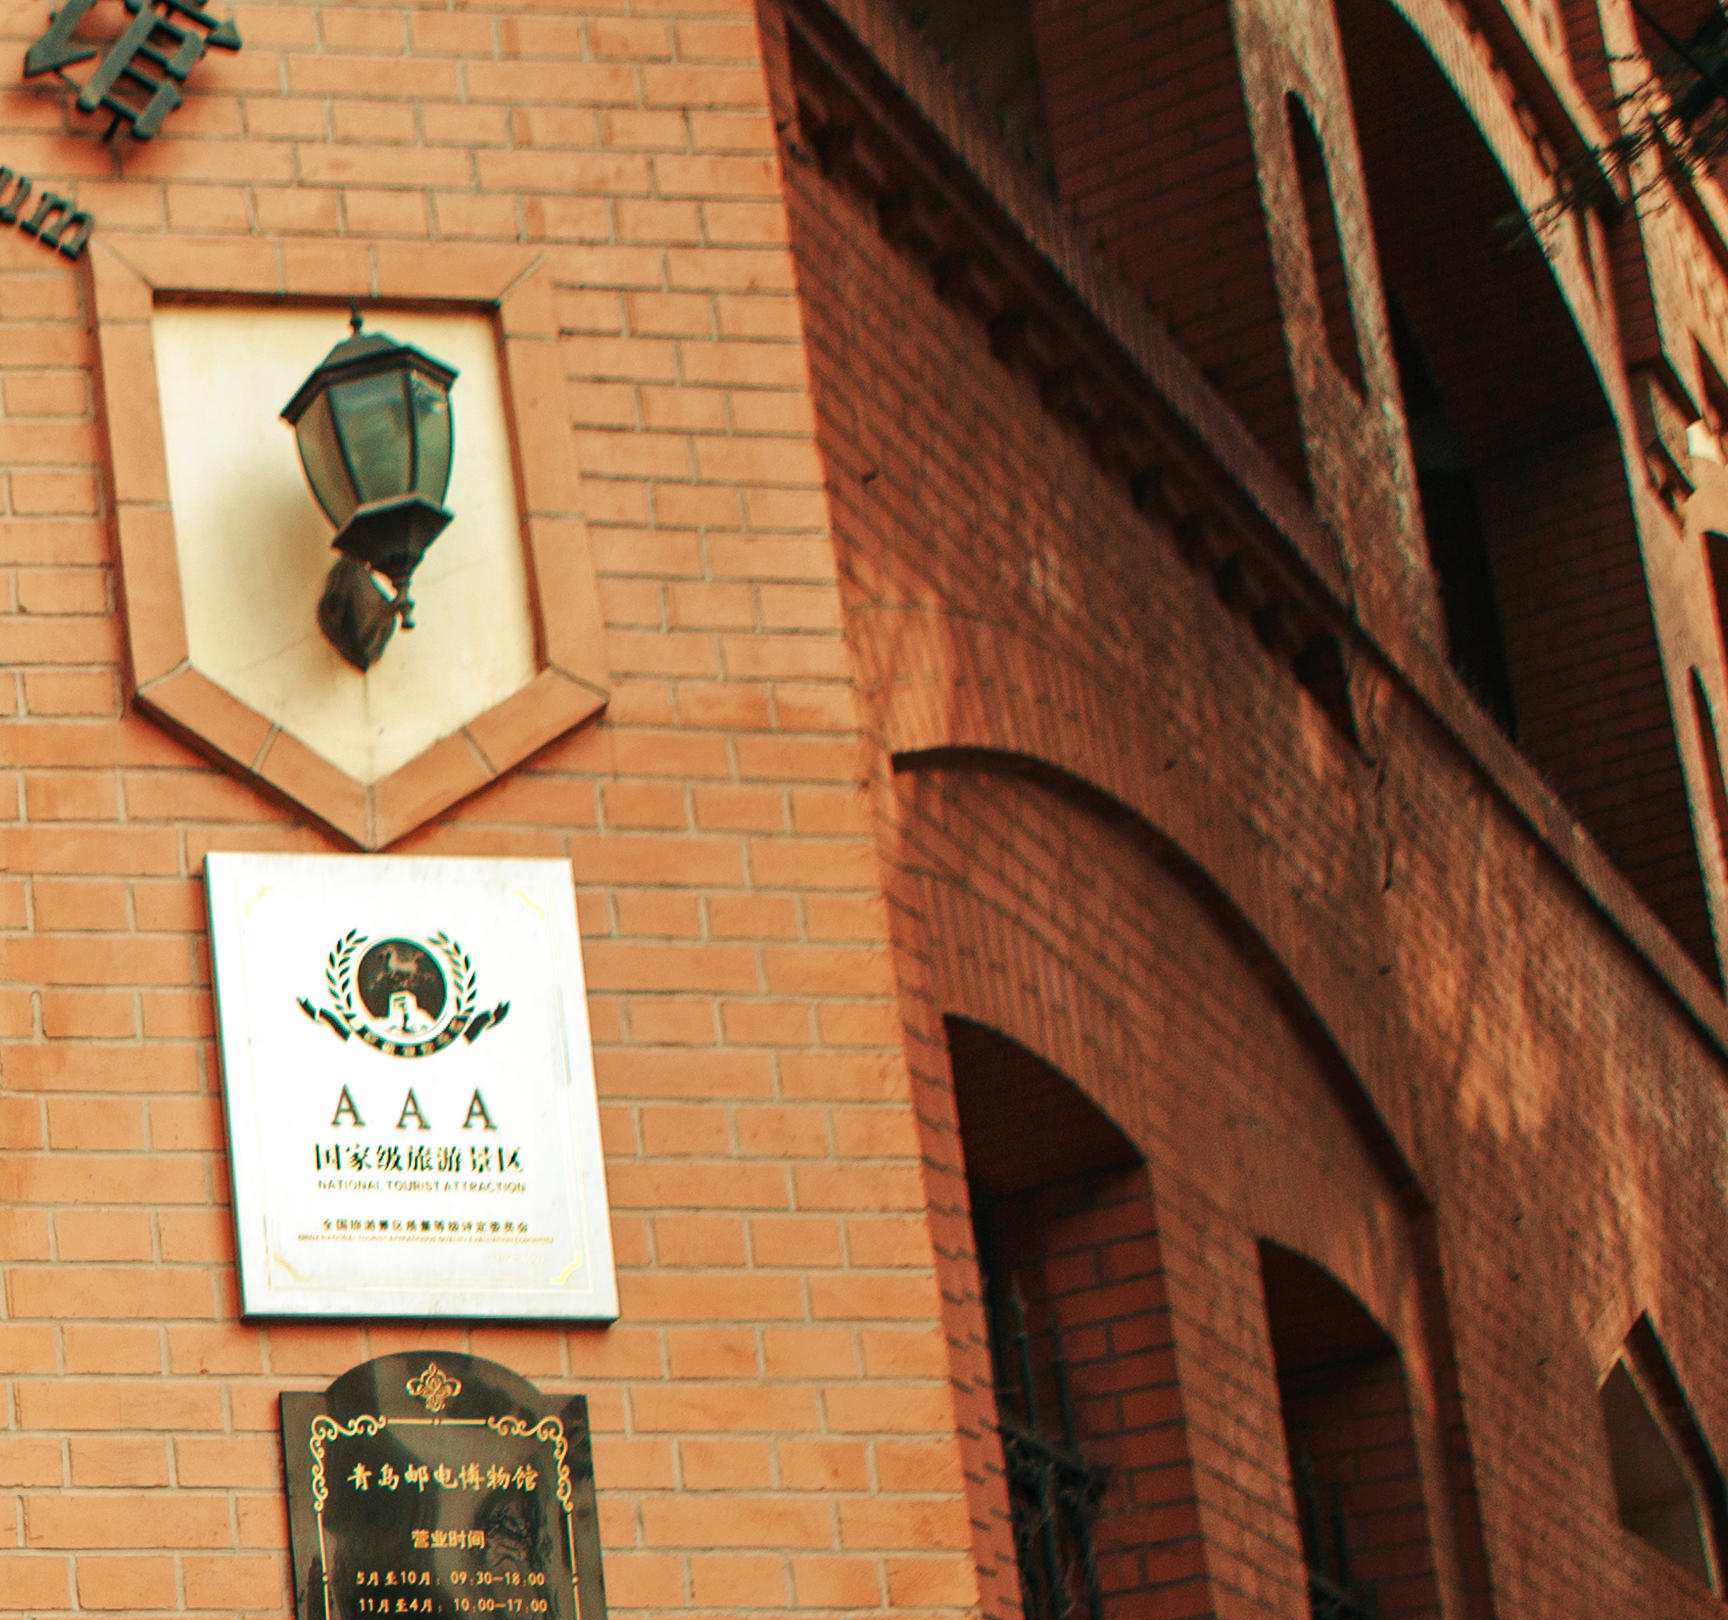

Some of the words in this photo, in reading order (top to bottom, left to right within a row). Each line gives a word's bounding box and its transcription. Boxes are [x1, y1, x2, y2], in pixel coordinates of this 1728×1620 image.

[315, 1143, 525, 1173] 国家级旅游景区
[318, 1180, 381, 1191] NATIONAL
[387, 1180, 439, 1192] TOURIST
[444, 1180, 526, 1193] ATTRACTION
[347, 1462, 540, 1493] 青岛邮电博物馆
[411, 1529, 486, 1549] 营业时间
